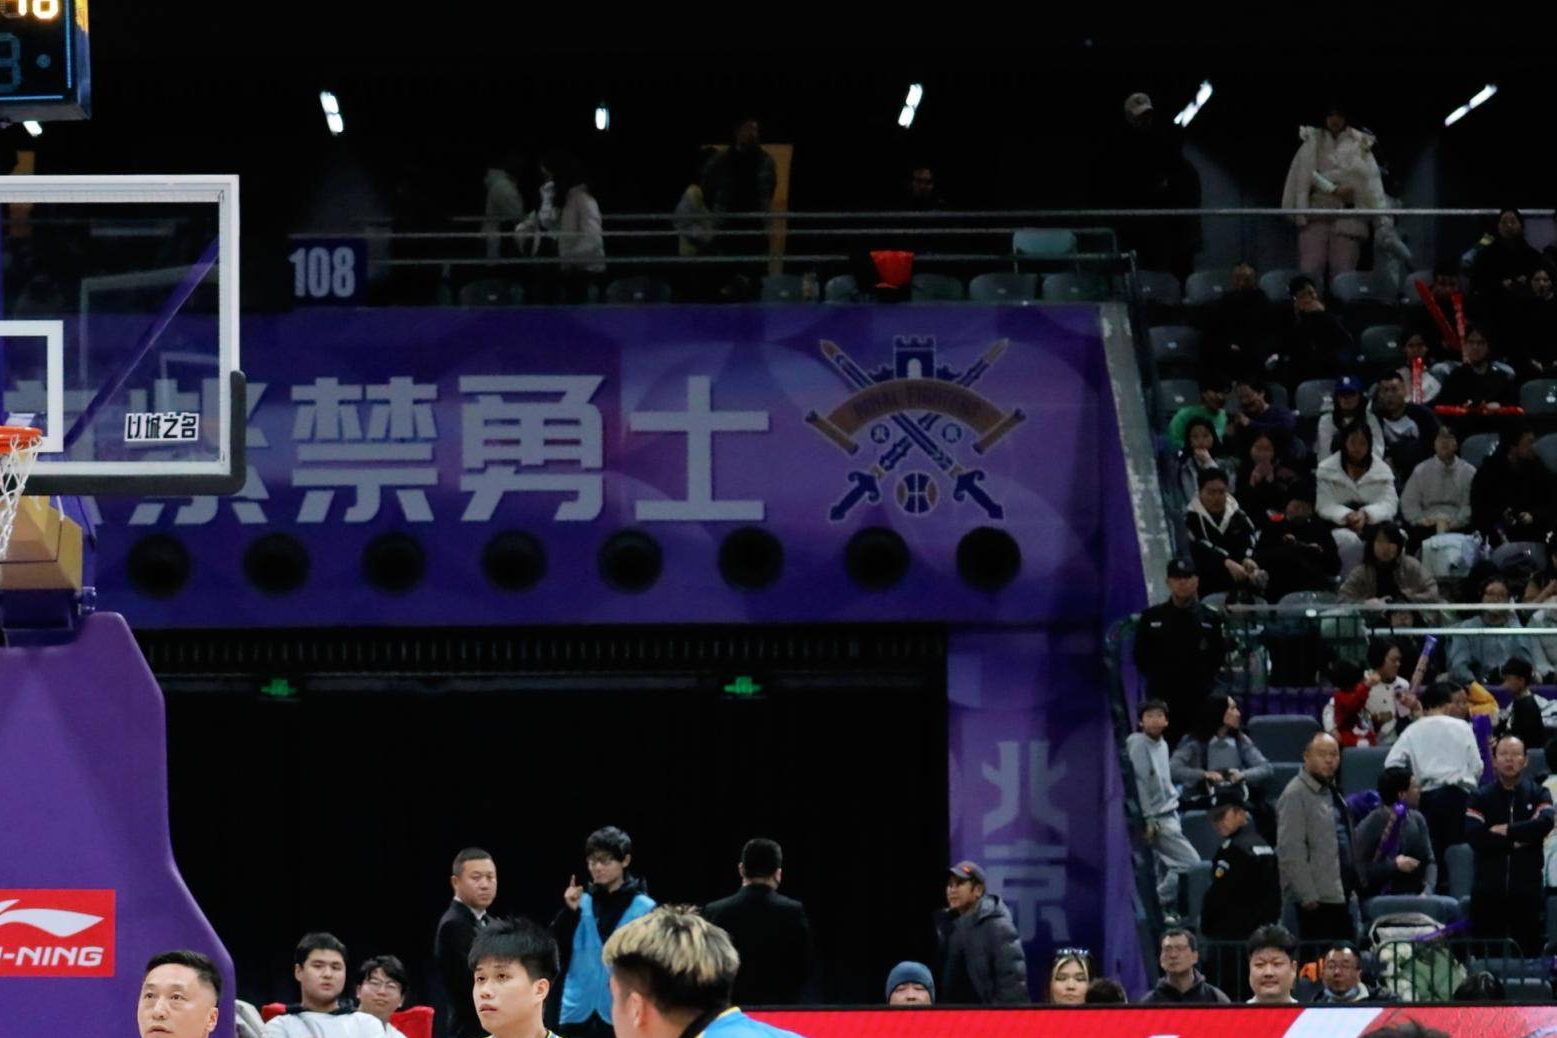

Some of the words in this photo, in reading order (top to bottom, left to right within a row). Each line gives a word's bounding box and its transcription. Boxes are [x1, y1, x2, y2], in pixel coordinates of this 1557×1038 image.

[289, 246, 355, 297] 108
[125, 412, 199, 441] 以城之名
